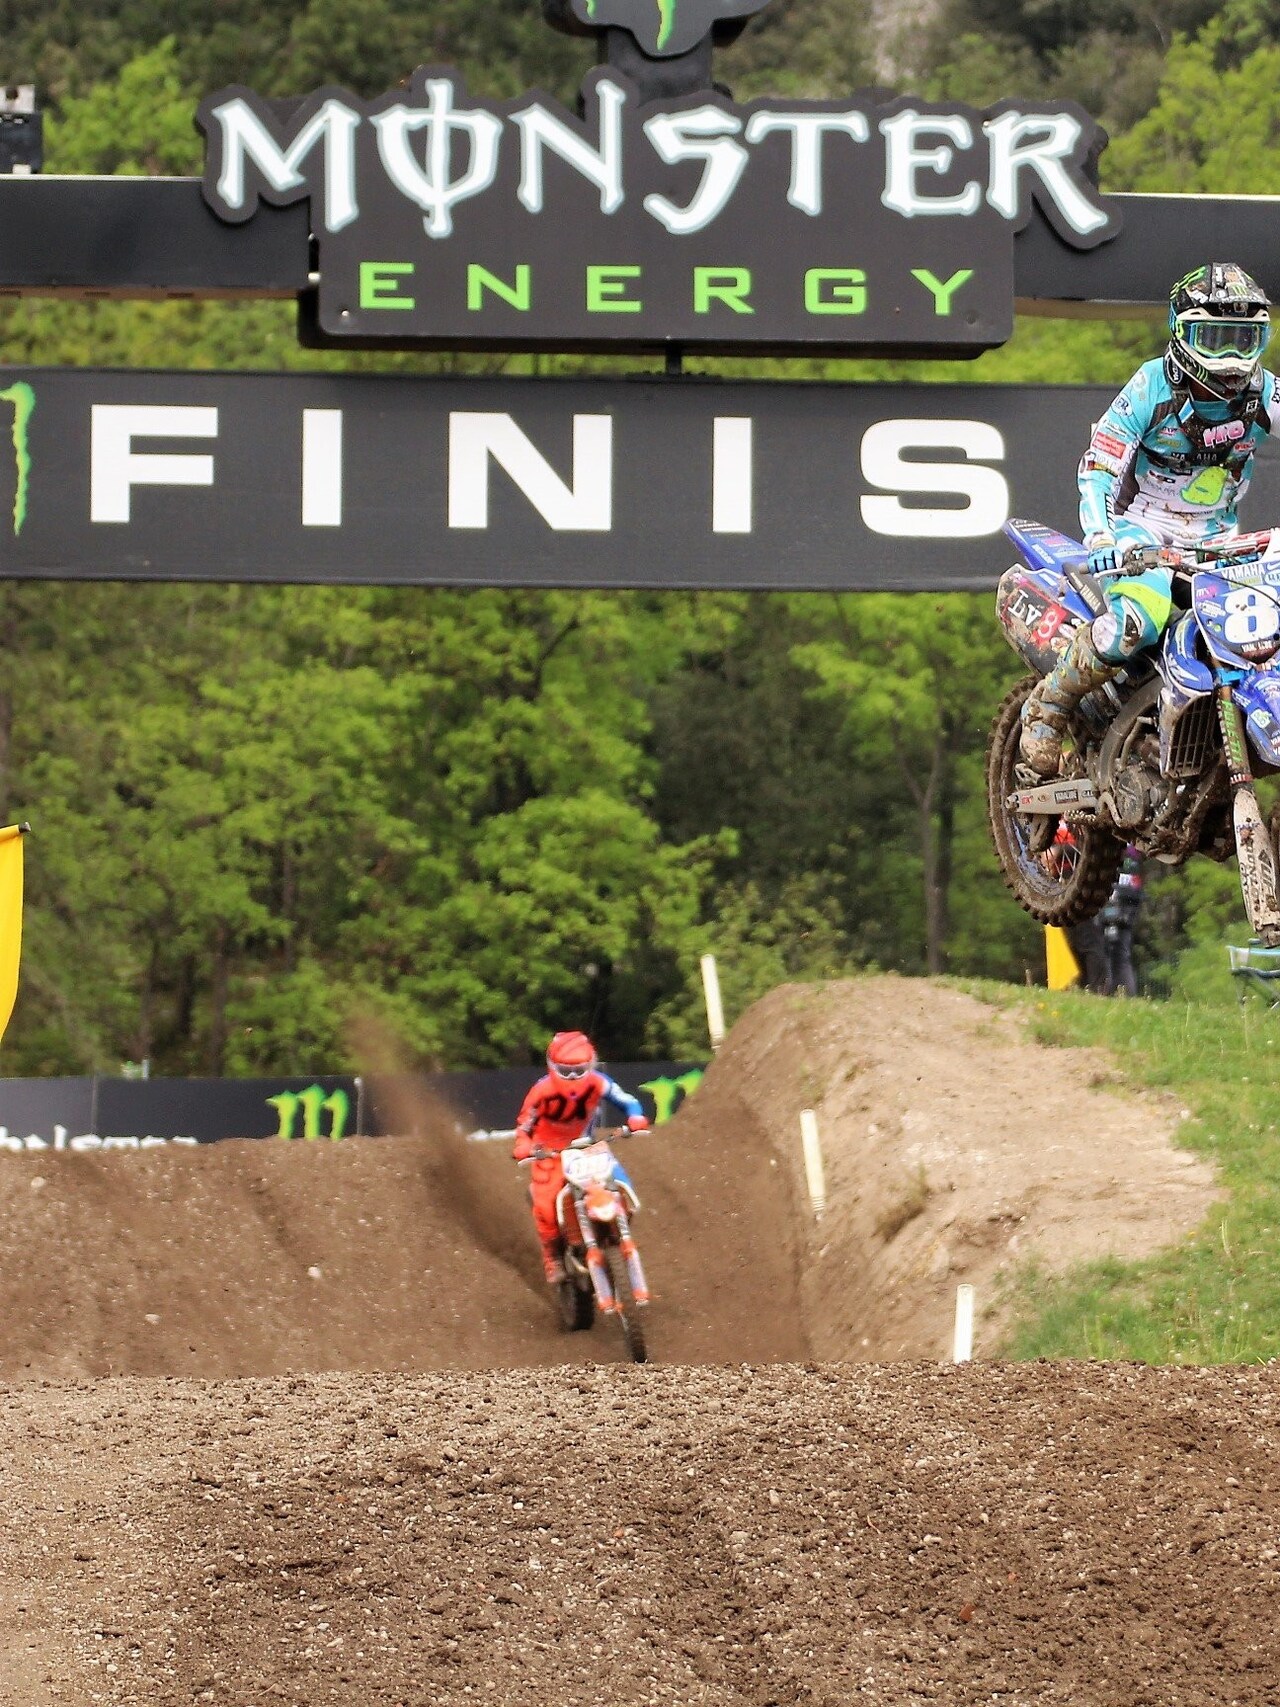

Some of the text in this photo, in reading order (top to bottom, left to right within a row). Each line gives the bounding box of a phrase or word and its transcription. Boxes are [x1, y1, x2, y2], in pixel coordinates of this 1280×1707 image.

[212, 78, 1108, 239] MONSTER
[359, 262, 974, 314] ENERGY
[91, 404, 1240, 538] FINIS
[1172, 452, 1218, 461] YAAHA
[1220, 563, 1266, 580] YAMAHA
[1224, 585, 1280, 643] 8
